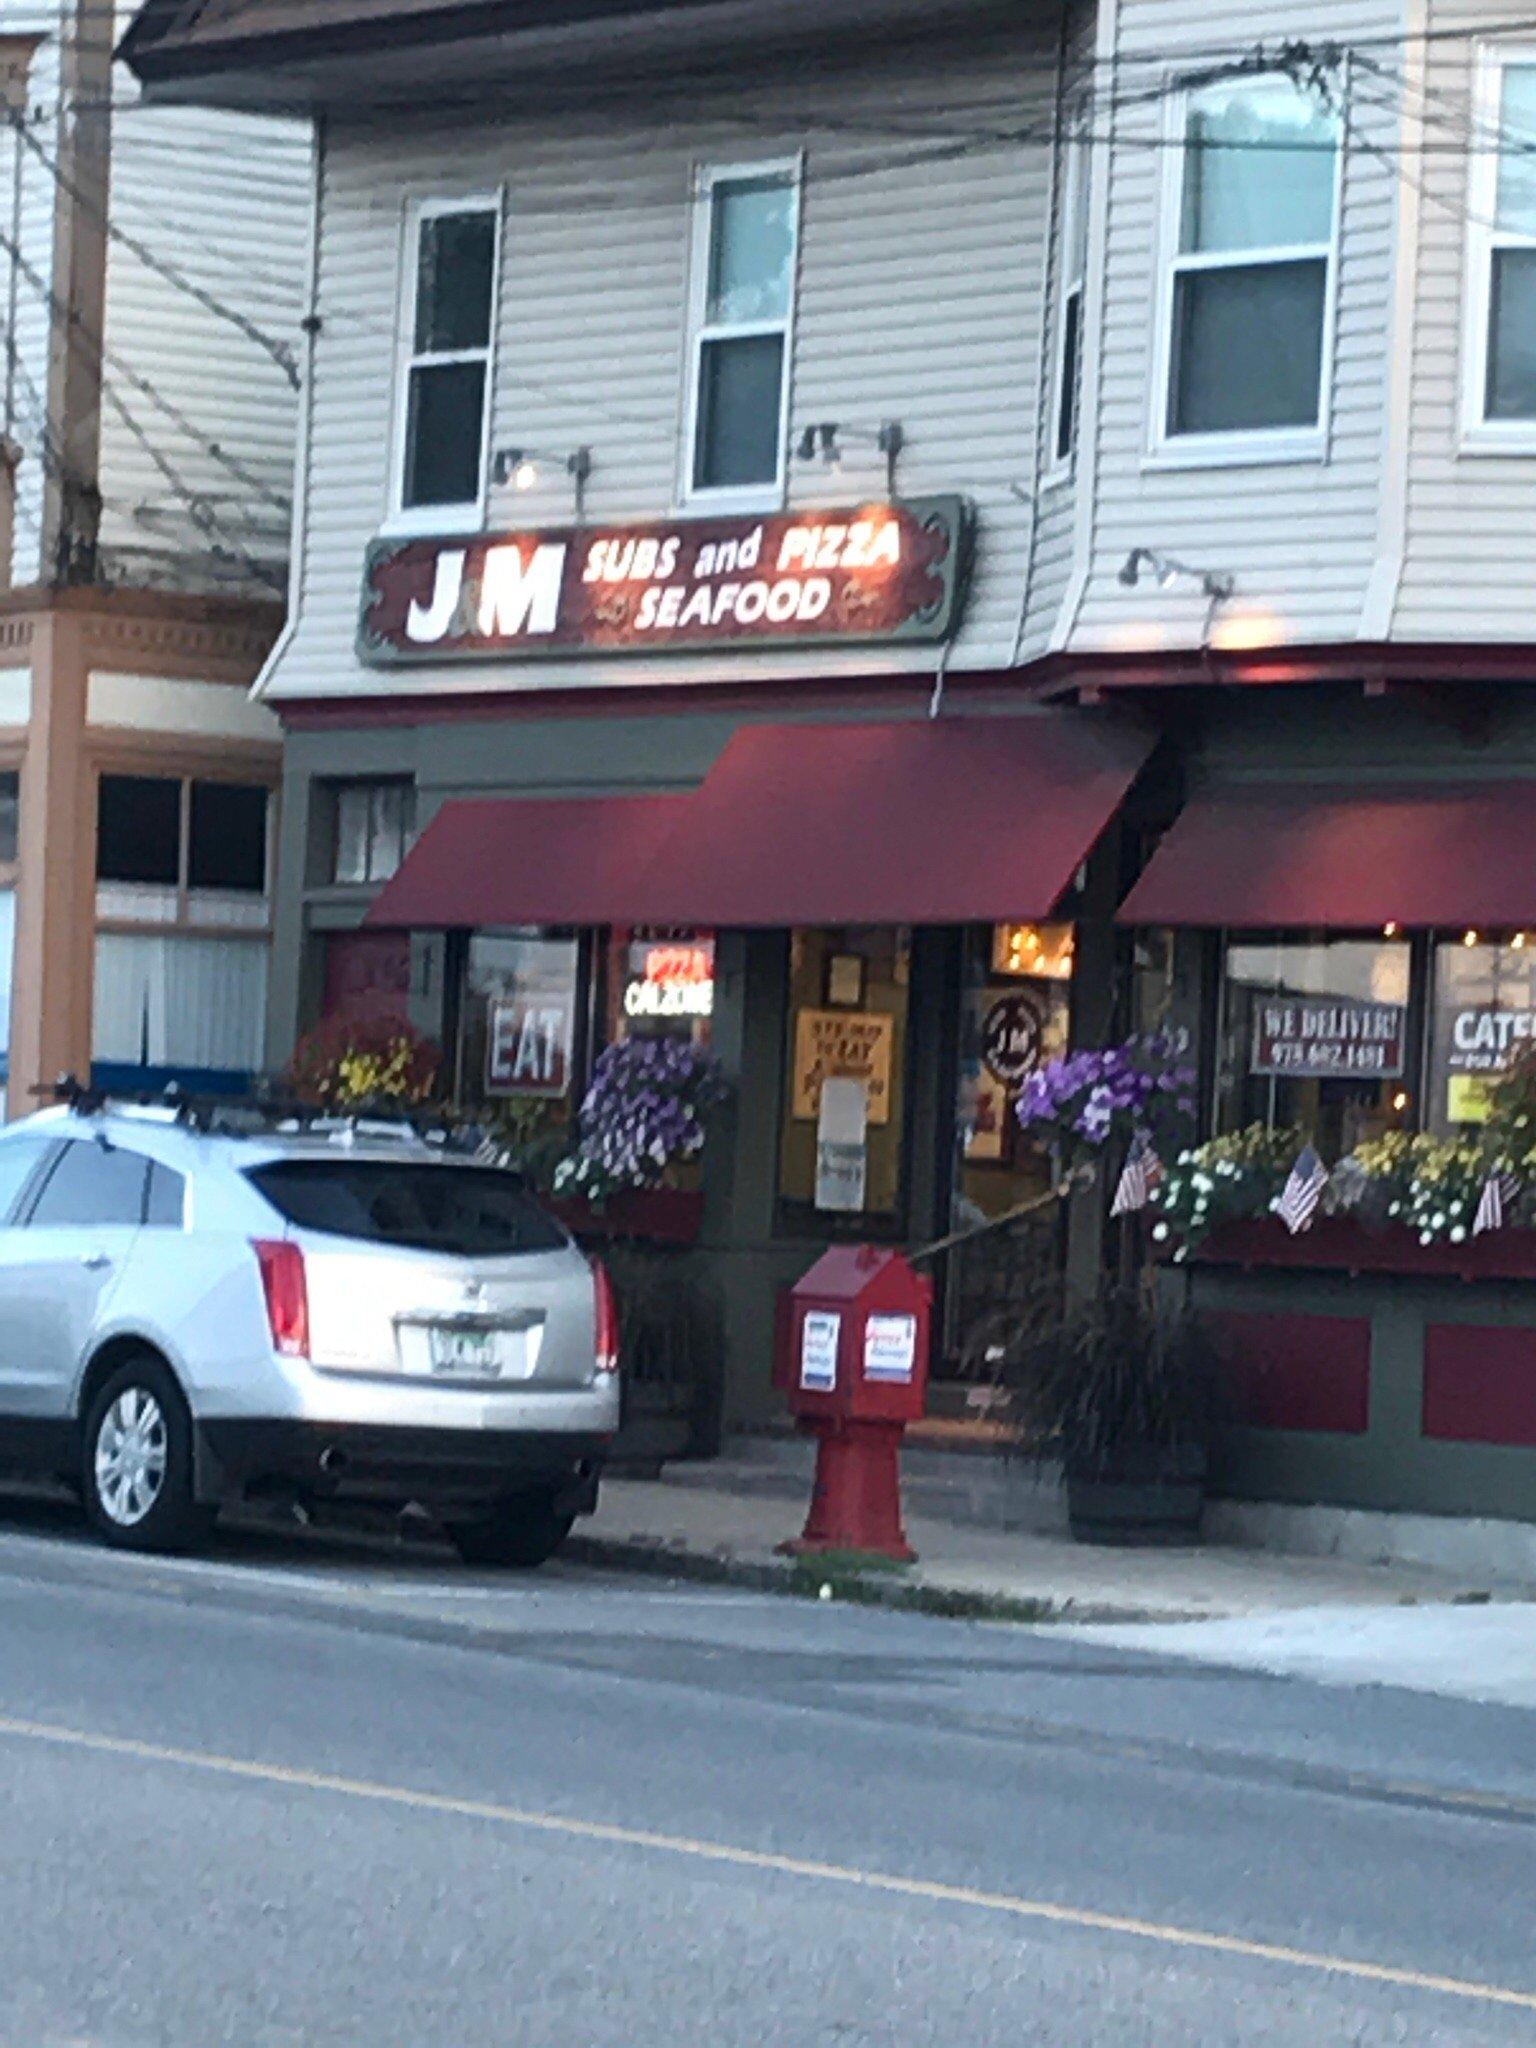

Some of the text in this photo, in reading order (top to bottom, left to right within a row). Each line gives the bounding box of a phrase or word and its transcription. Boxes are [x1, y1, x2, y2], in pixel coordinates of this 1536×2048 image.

[582, 535, 680, 582] SUBS
[693, 525, 762, 578] and
[775, 521, 900, 571] PIZZA
[634, 577, 831, 630] SEAFOOD
[490, 1006, 564, 1080] EAT
[1265, 1008, 1295, 1038] WE
[1454, 1011, 1536, 1050] CATE
